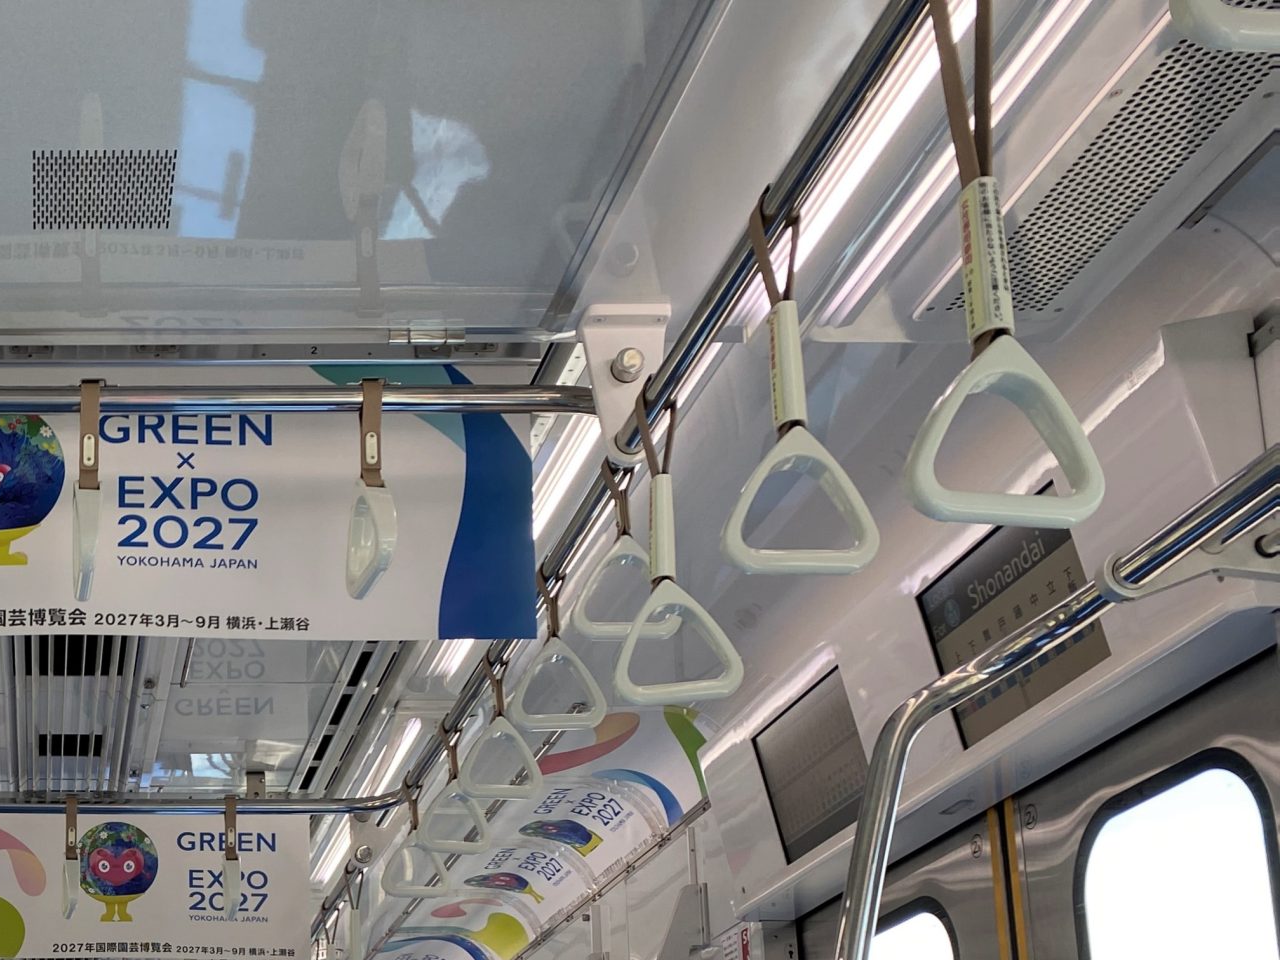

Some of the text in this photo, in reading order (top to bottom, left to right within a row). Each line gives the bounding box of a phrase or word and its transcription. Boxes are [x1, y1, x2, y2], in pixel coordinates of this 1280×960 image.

[98, 414, 273, 446] GREEN
[117, 476, 259, 512] EXPO
[117, 514, 259, 551] 2027
[117, 556, 258, 569] YOKOHAMA JAPAN
[967, 530, 1046, 610] Shonandai
[226, 615, 310, 631] 横浜・上瀬谷
[535, 787, 573, 815] GREEN
[571, 792, 607, 817] EXPO
[592, 798, 625, 827] 2027
[485, 847, 517, 870] GREEN
[517, 850, 548, 872] EXPO
[536, 857, 564, 882] 2027
[188, 869, 268, 890] EXO
[189, 914, 238, 923] YOKOHA
[53, 942, 172, 953] 2027年国際園芸博覧会
